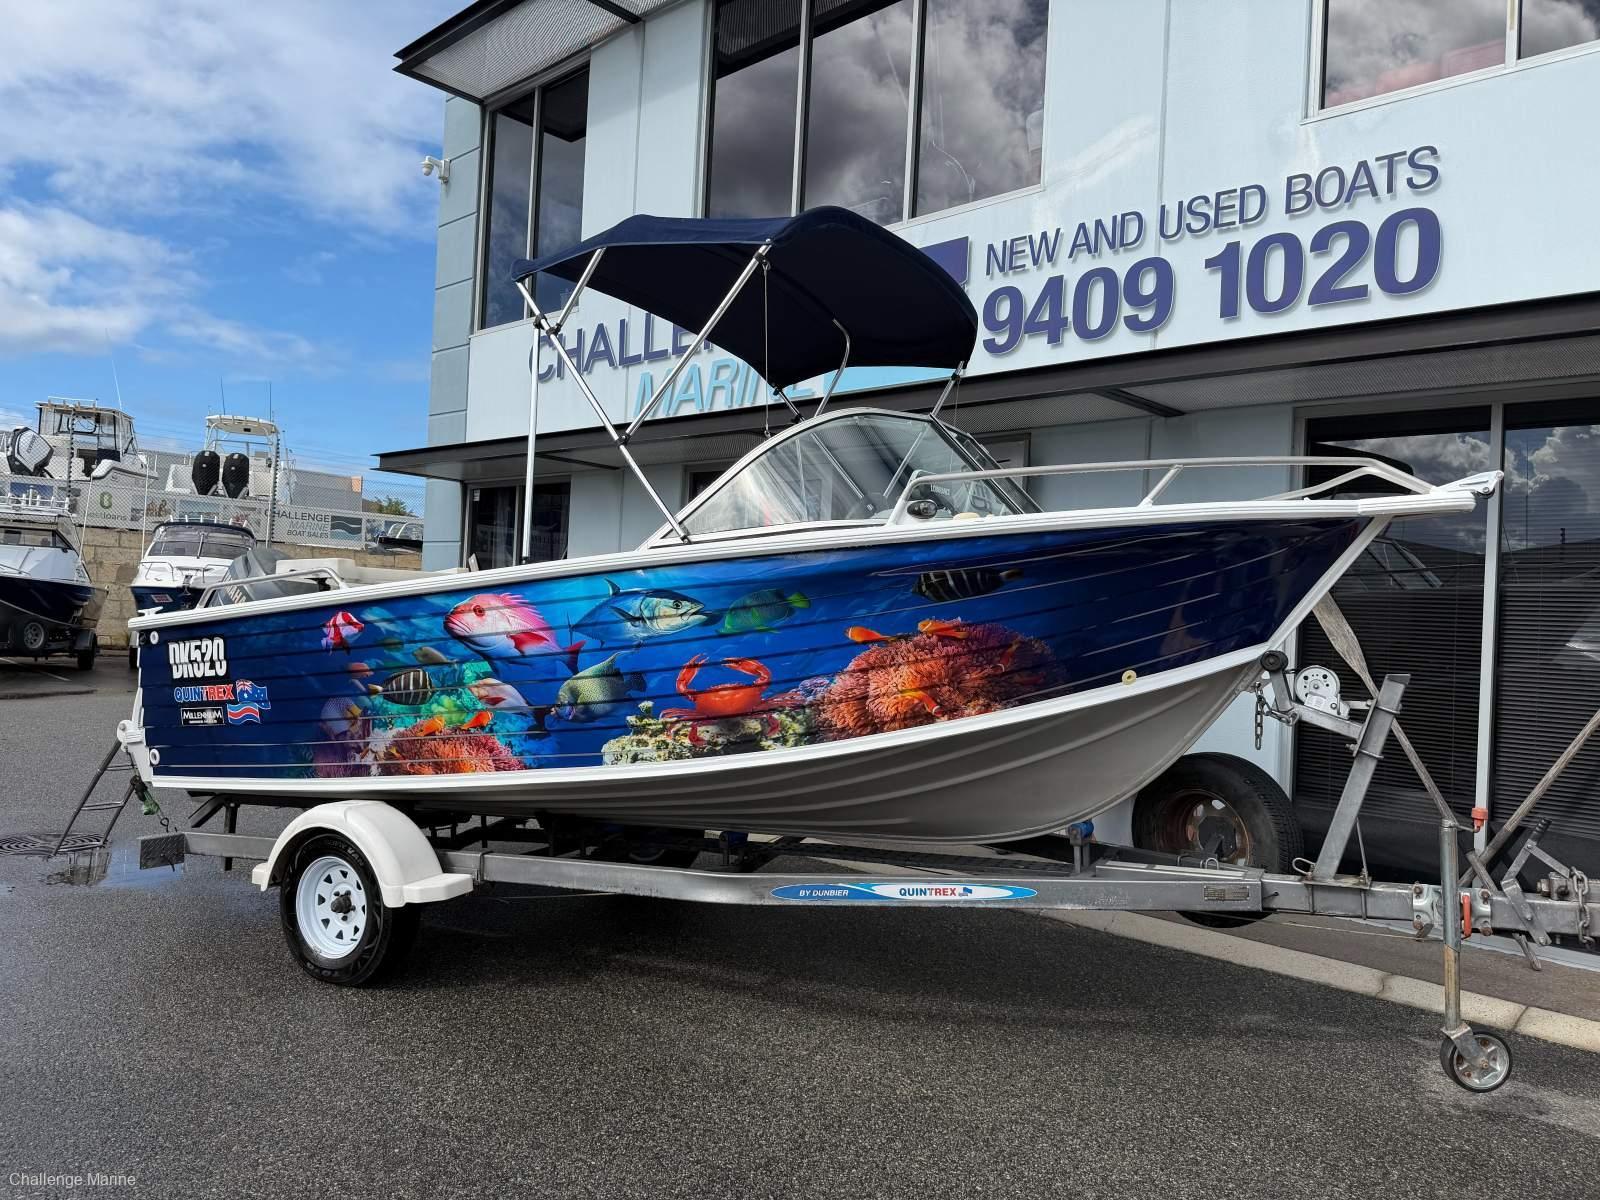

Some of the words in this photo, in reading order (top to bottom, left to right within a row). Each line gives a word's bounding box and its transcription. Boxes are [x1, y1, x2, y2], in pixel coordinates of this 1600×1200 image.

[984, 228, 1061, 276] NEW
[1069, 211, 1143, 260] AND
[1159, 183, 1267, 240] USED
[1285, 145, 1440, 215] BOATS
[982, 256, 1175, 355] 9409
[1204, 207, 1442, 320] 1020
[529, 312, 711, 382] CHALLE
[264, 509, 330, 523] CHALLENGE
[289, 520, 329, 533] MARINE
[307, 531, 329, 539] SALES
[168, 637, 227, 679] DK520
[174, 684, 235, 703] QUINTREX
[799, 889, 811, 897] BY
[812, 889, 849, 897] DUNBIER
[899, 887, 957, 897] QUINTREX
